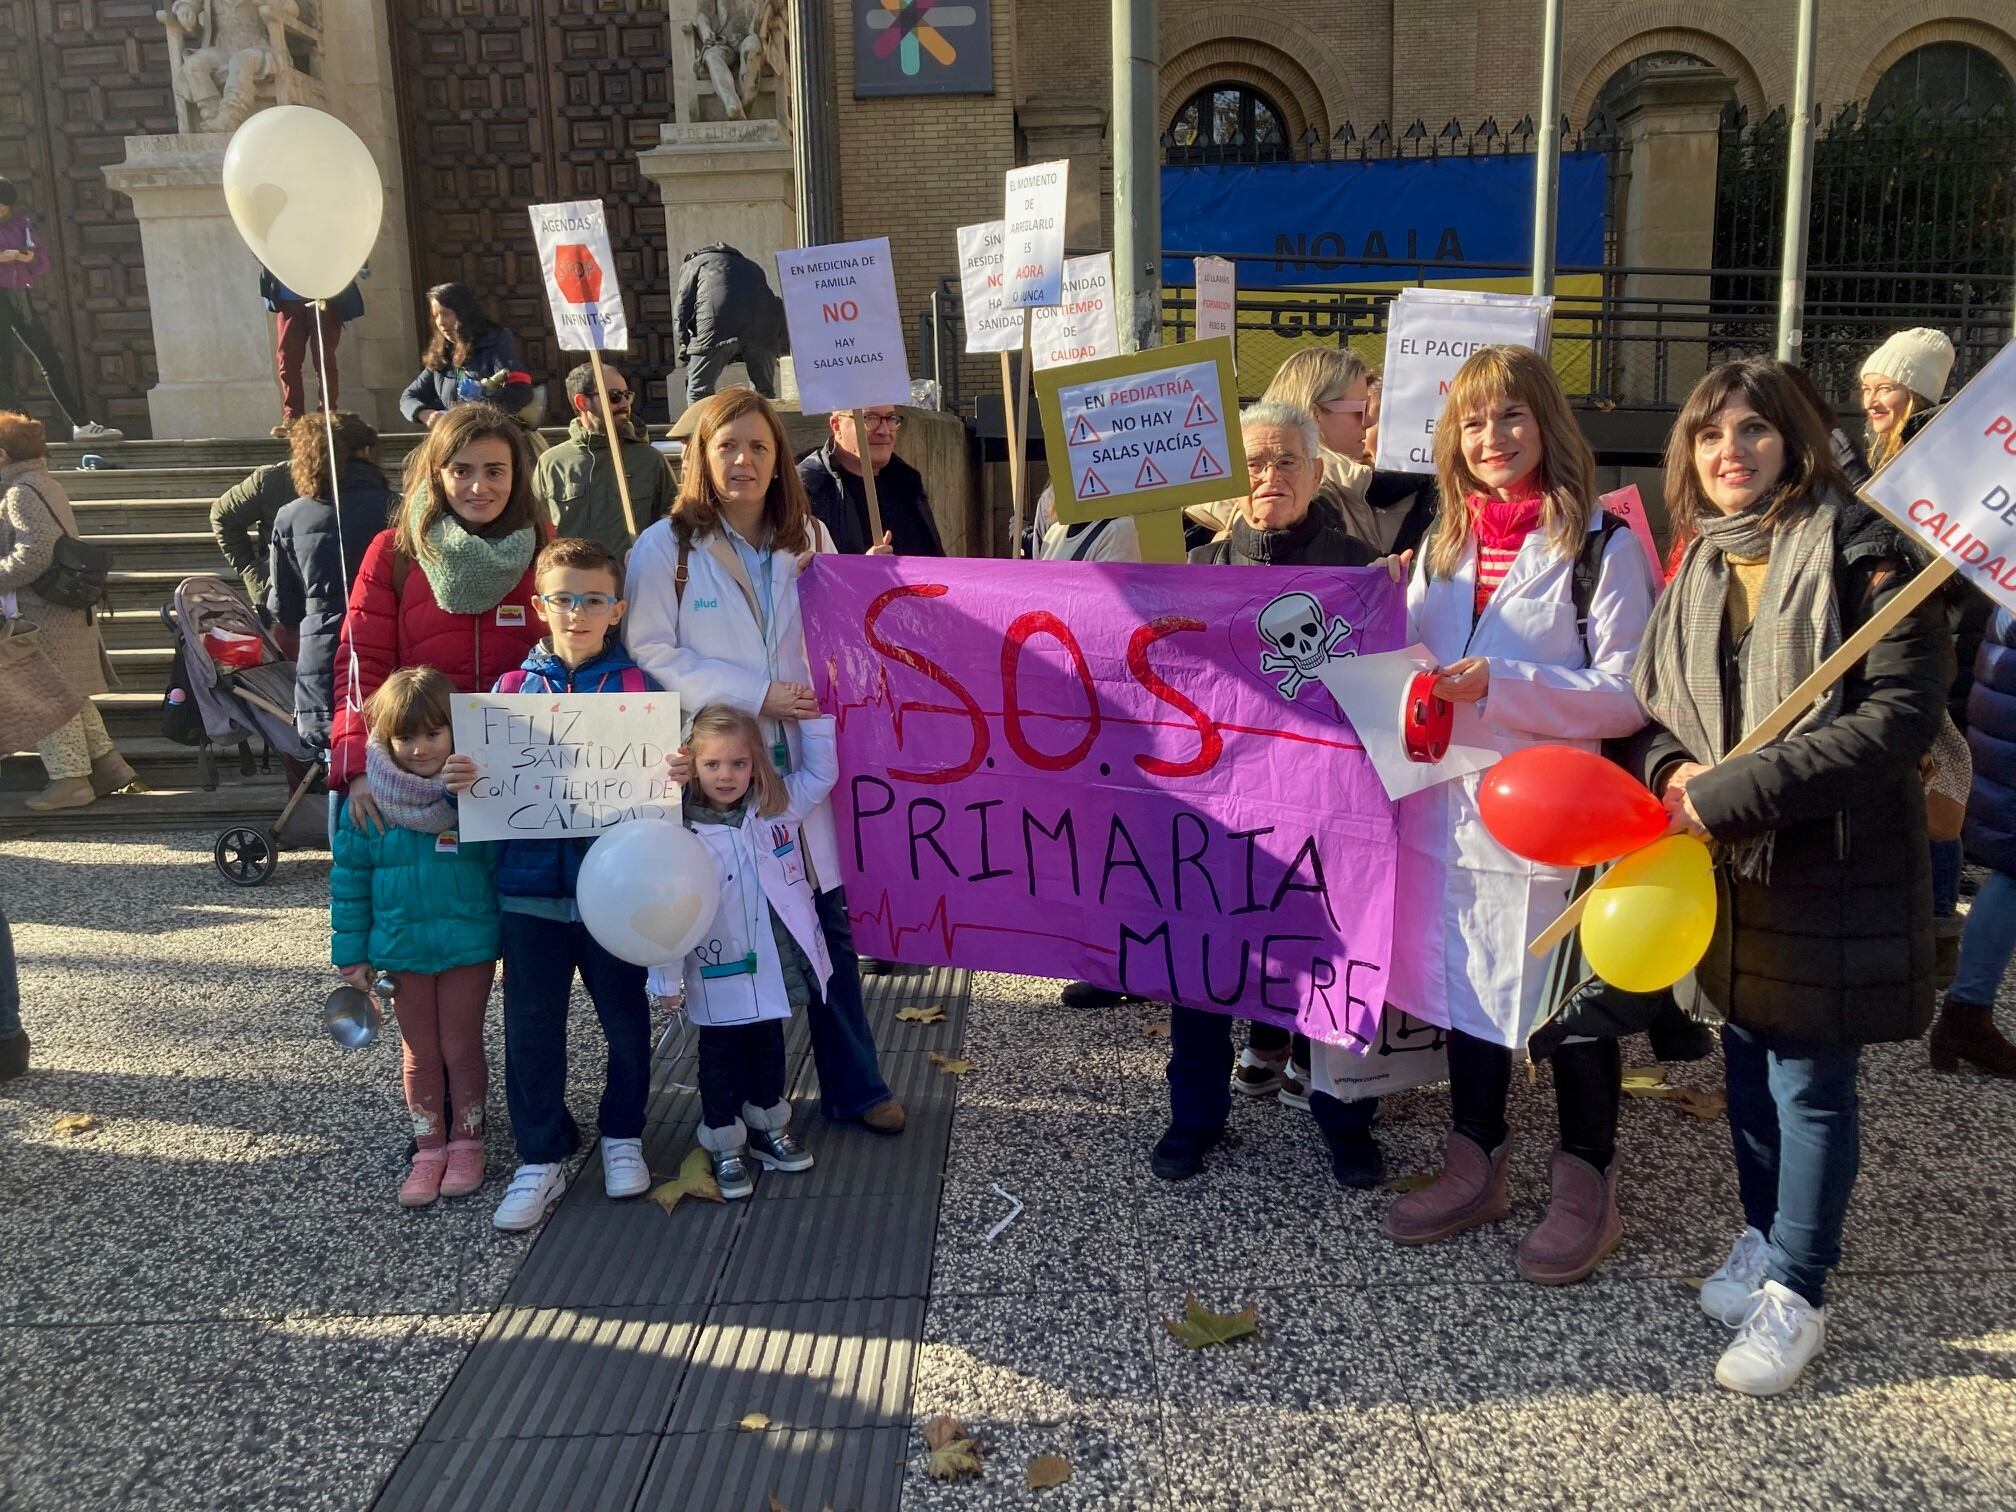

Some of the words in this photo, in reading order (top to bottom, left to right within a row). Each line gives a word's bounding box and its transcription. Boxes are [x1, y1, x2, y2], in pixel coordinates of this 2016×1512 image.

[1010, 180, 1017, 192] EL
[1017, 172, 1057, 189] MOMENTO
[1024, 198, 1035, 211] DE
[541, 217, 592, 233] AGENDAS
[984, 233, 1001, 247] SIN
[1024, 242, 1032, 254] ES
[1275, 230, 1346, 272] NO
[1359, 229, 1393, 268] A
[791, 266, 805, 276] EN
[807, 258, 859, 273] MEDICINA
[861, 256, 876, 266] DE
[815, 276, 857, 289] FAMILIA
[1062, 275, 1106, 293] ANIDAD
[989, 297, 1003, 310] HA
[1012, 291, 1019, 303] O
[822, 300, 859, 324] NO
[1036, 307, 1058, 320] CON
[1061, 299, 1103, 316] TIEMPO
[561, 312, 612, 327] INFINITAS
[978, 314, 1024, 331] SANIDAD
[1063, 325, 1077, 338] DE
[834, 337, 856, 348] HAY
[1400, 338, 1419, 355] EL
[1425, 340, 1488, 358] PACIE
[813, 356, 844, 369] SALAS
[845, 352, 884, 366] VACIAS
[1050, 345, 1096, 362] CALIDAD
[1084, 394, 1105, 410] EN
[1109, 376, 1195, 407] PEDIATRÍA
[1112, 417, 1137, 433] NO
[1141, 410, 1173, 429] HAY
[1092, 443, 1140, 464] SALAS
[1143, 432, 1202, 456] VACÍAS
[1907, 497, 2016, 593] CALIDAD
[649, 778, 674, 800] DE
[850, 774, 1341, 933] PRIMARIA
[1118, 920, 1380, 1052] MUERE
